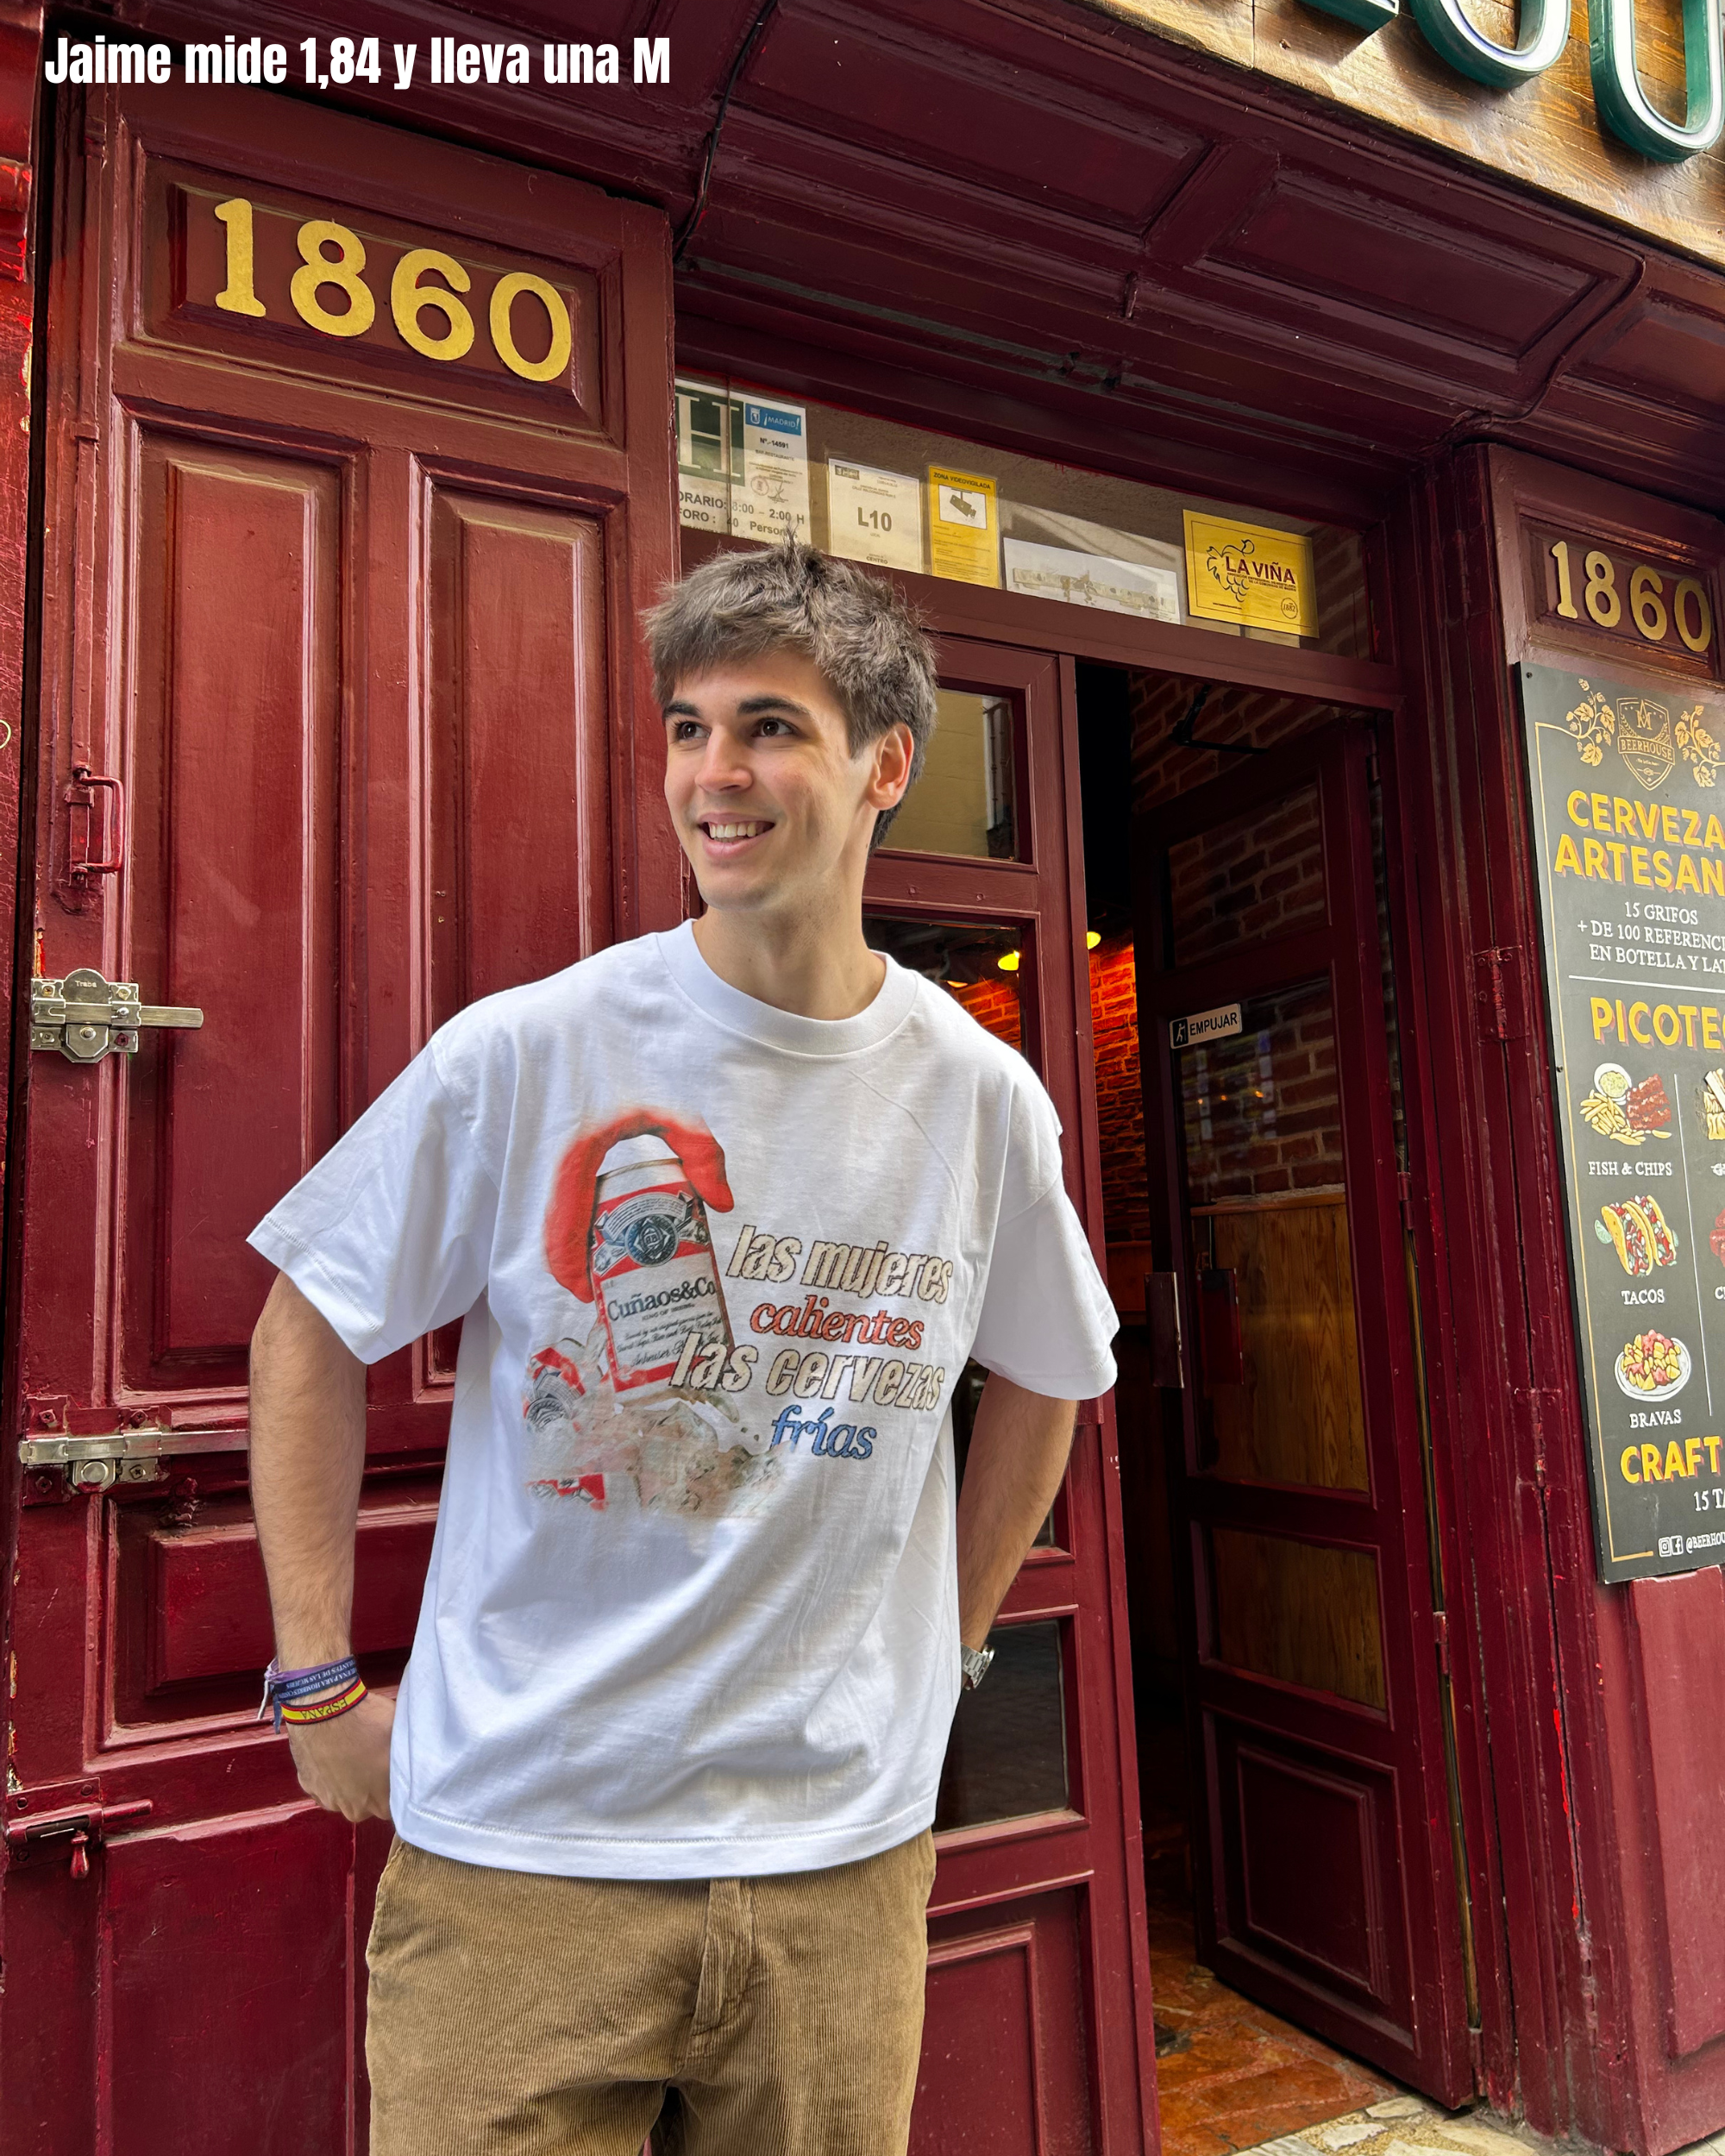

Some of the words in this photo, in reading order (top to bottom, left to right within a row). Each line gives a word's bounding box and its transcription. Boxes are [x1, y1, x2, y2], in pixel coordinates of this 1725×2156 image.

[215, 197, 571, 382] 1860
[933, 472, 949, 480] ZONA
[768, 509, 792, 522] 2:00
[796, 513, 805, 525] H
[857, 506, 893, 532] L10
[1225, 555, 1251, 576] LA
[1251, 561, 1296, 585] VIÑA
[1551, 540, 1712, 653] 1860
[1620, 739, 1673, 761] BEERHOUSE
[1566, 789, 1725, 851] CERVEZA
[1554, 832, 1725, 898] ARTESAN
[1624, 901, 1640, 918] 15
[1643, 904, 1699, 925] GRIFOS
[1590, 919, 1614, 937] DE
[1617, 924, 1640, 941] 100
[1589, 943, 1612, 962] EN
[1615, 947, 1687, 969] BOTELLA
[1687, 955, 1698, 971] Y
[1189, 1012, 1238, 1037] EMPUJAR
[1588, 1161, 1619, 1175] FISH
[1621, 1162, 1633, 1175] &
[1634, 1161, 1672, 1176] CHIPS
[725, 1224, 802, 1283] las
[800, 1240, 953, 1304] mujeres
[1621, 1288, 1665, 1305] TACOS
[750, 1294, 925, 1351] calientes
[668, 1331, 759, 1392] las
[764, 1348, 945, 1412] cervezas
[1629, 1408, 1682, 1429] BRAVAS
[769, 1404, 878, 1461] frías
[1620, 1435, 1722, 1484] CRAFT
[1693, 1490, 1709, 1512] 15
